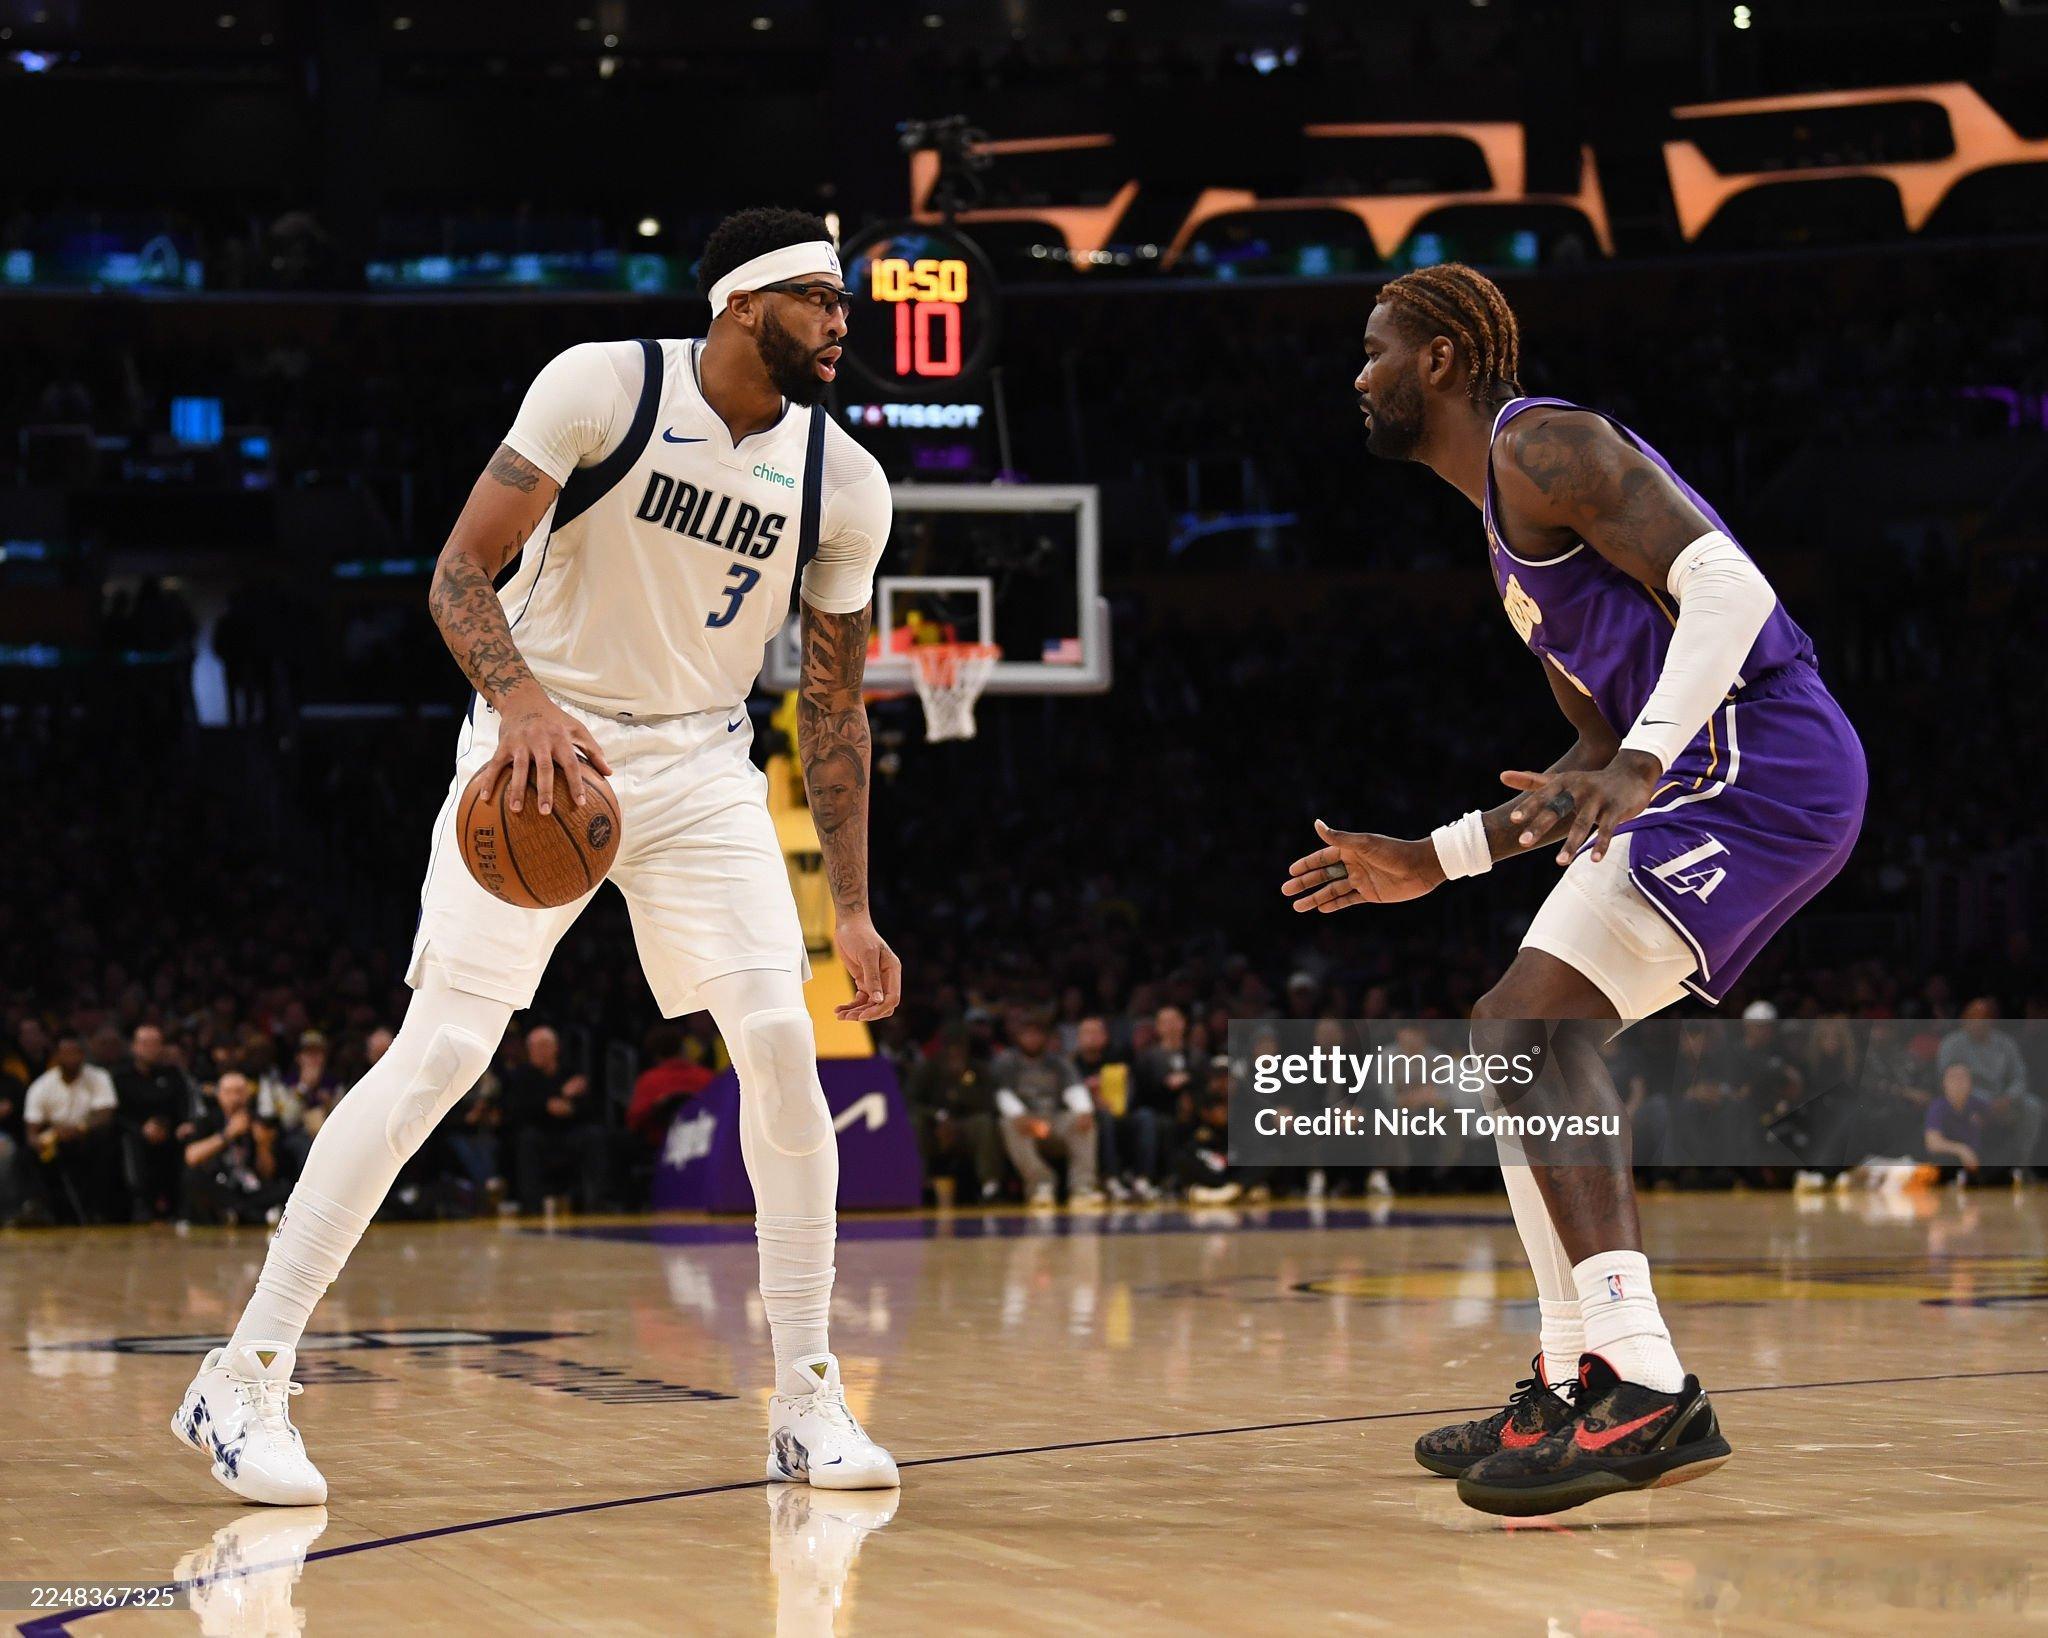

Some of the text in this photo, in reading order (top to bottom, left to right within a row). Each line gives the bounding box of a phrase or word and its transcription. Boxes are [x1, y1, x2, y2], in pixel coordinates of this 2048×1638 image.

[871, 258, 968, 303] 10:50
[895, 302, 961, 377] 10
[752, 462, 796, 489] chime
[635, 469, 788, 560] DALLAS
[704, 562, 762, 629] 3
[1641, 832, 1731, 904] LA
